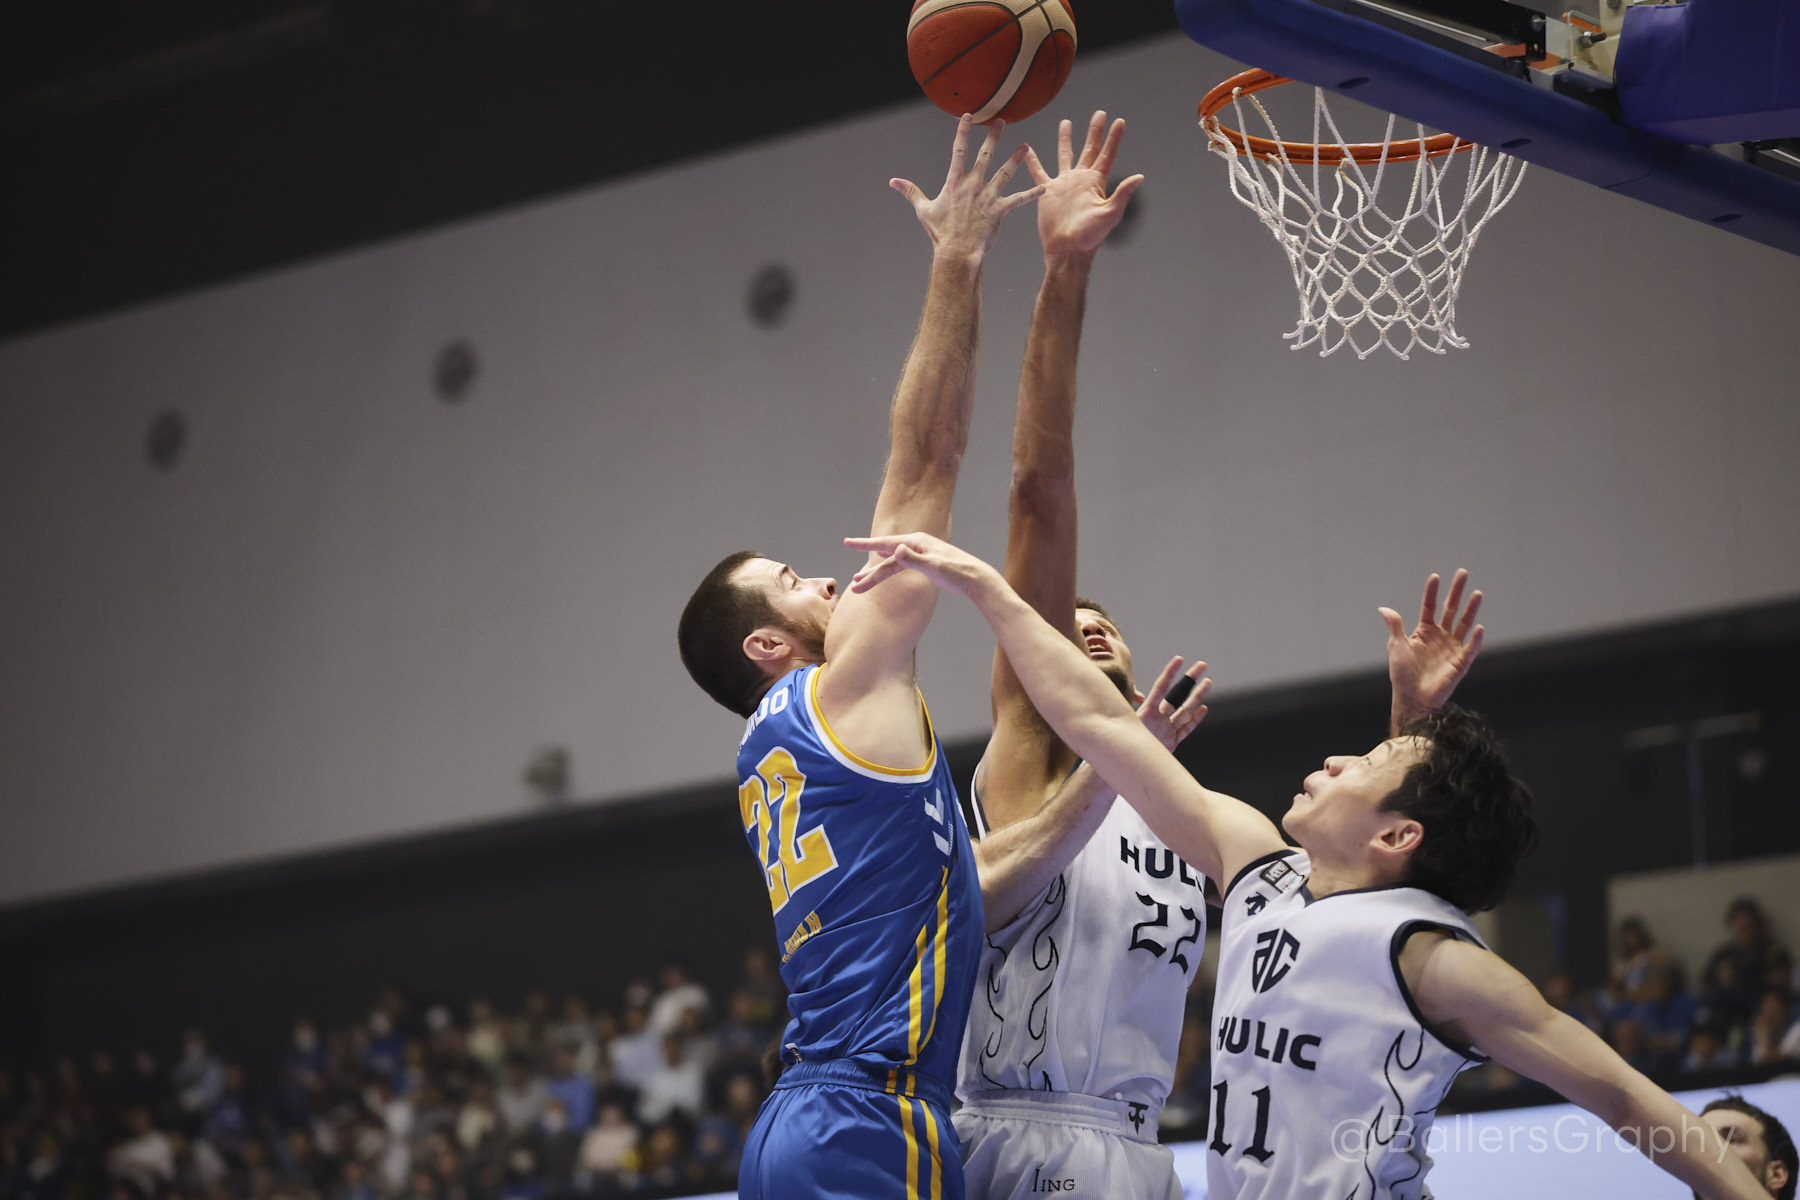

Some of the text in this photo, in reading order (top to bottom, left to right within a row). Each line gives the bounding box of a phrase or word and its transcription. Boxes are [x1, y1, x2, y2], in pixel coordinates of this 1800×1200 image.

[739, 745, 839, 917] 22
[1120, 835, 1203, 892] HUL
[1128, 891, 1201, 975] 22
[1217, 1016, 1322, 1071] HULIC
[1209, 1079, 1275, 1164] 11
